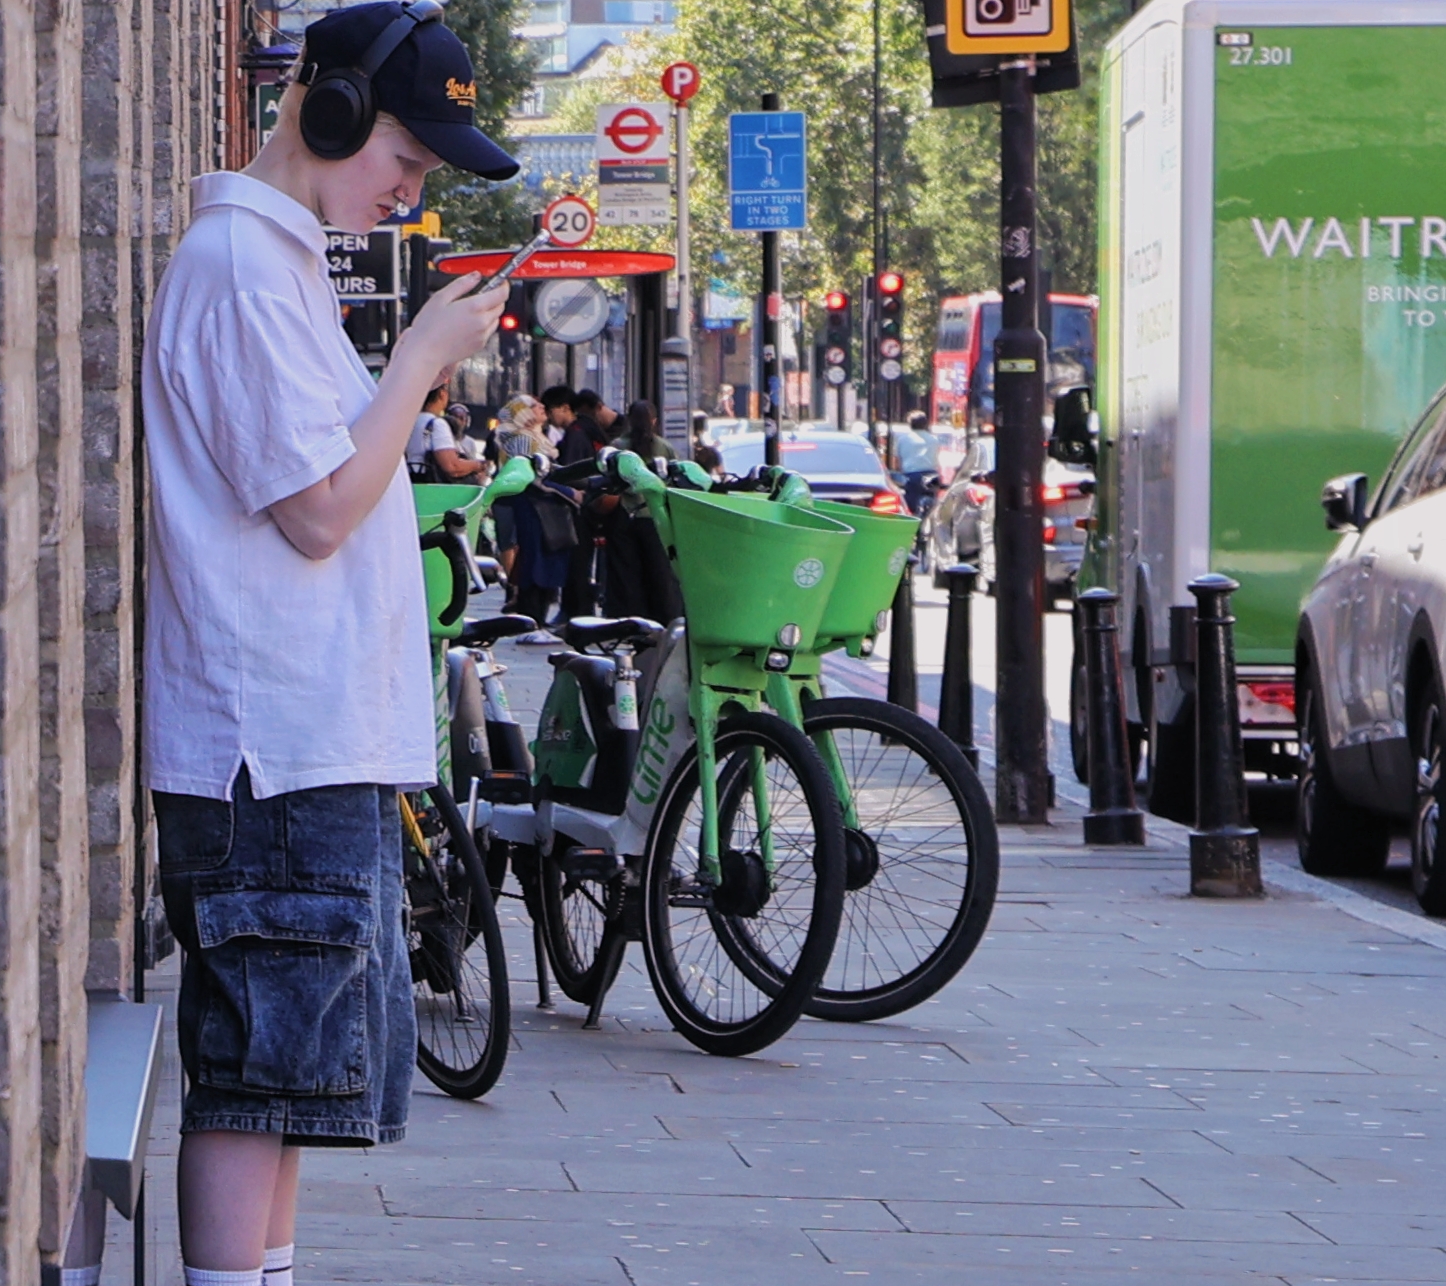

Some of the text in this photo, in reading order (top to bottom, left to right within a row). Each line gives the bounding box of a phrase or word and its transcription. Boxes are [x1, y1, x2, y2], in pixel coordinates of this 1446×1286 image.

[1229, 46, 1292, 65] 27.301
[673, 66, 694, 95] P
[734, 194, 802, 205] RIGHT TURN
[747, 205, 789, 215] IN TWO
[553, 212, 588, 232] 20
[746, 215, 790, 226] STAGES
[328, 235, 370, 251] PEN
[330, 255, 353, 272] 24
[532, 260, 587, 270] Tower Bridge
[330, 276, 377, 293] URS
[1403, 309, 1437, 328] TO
